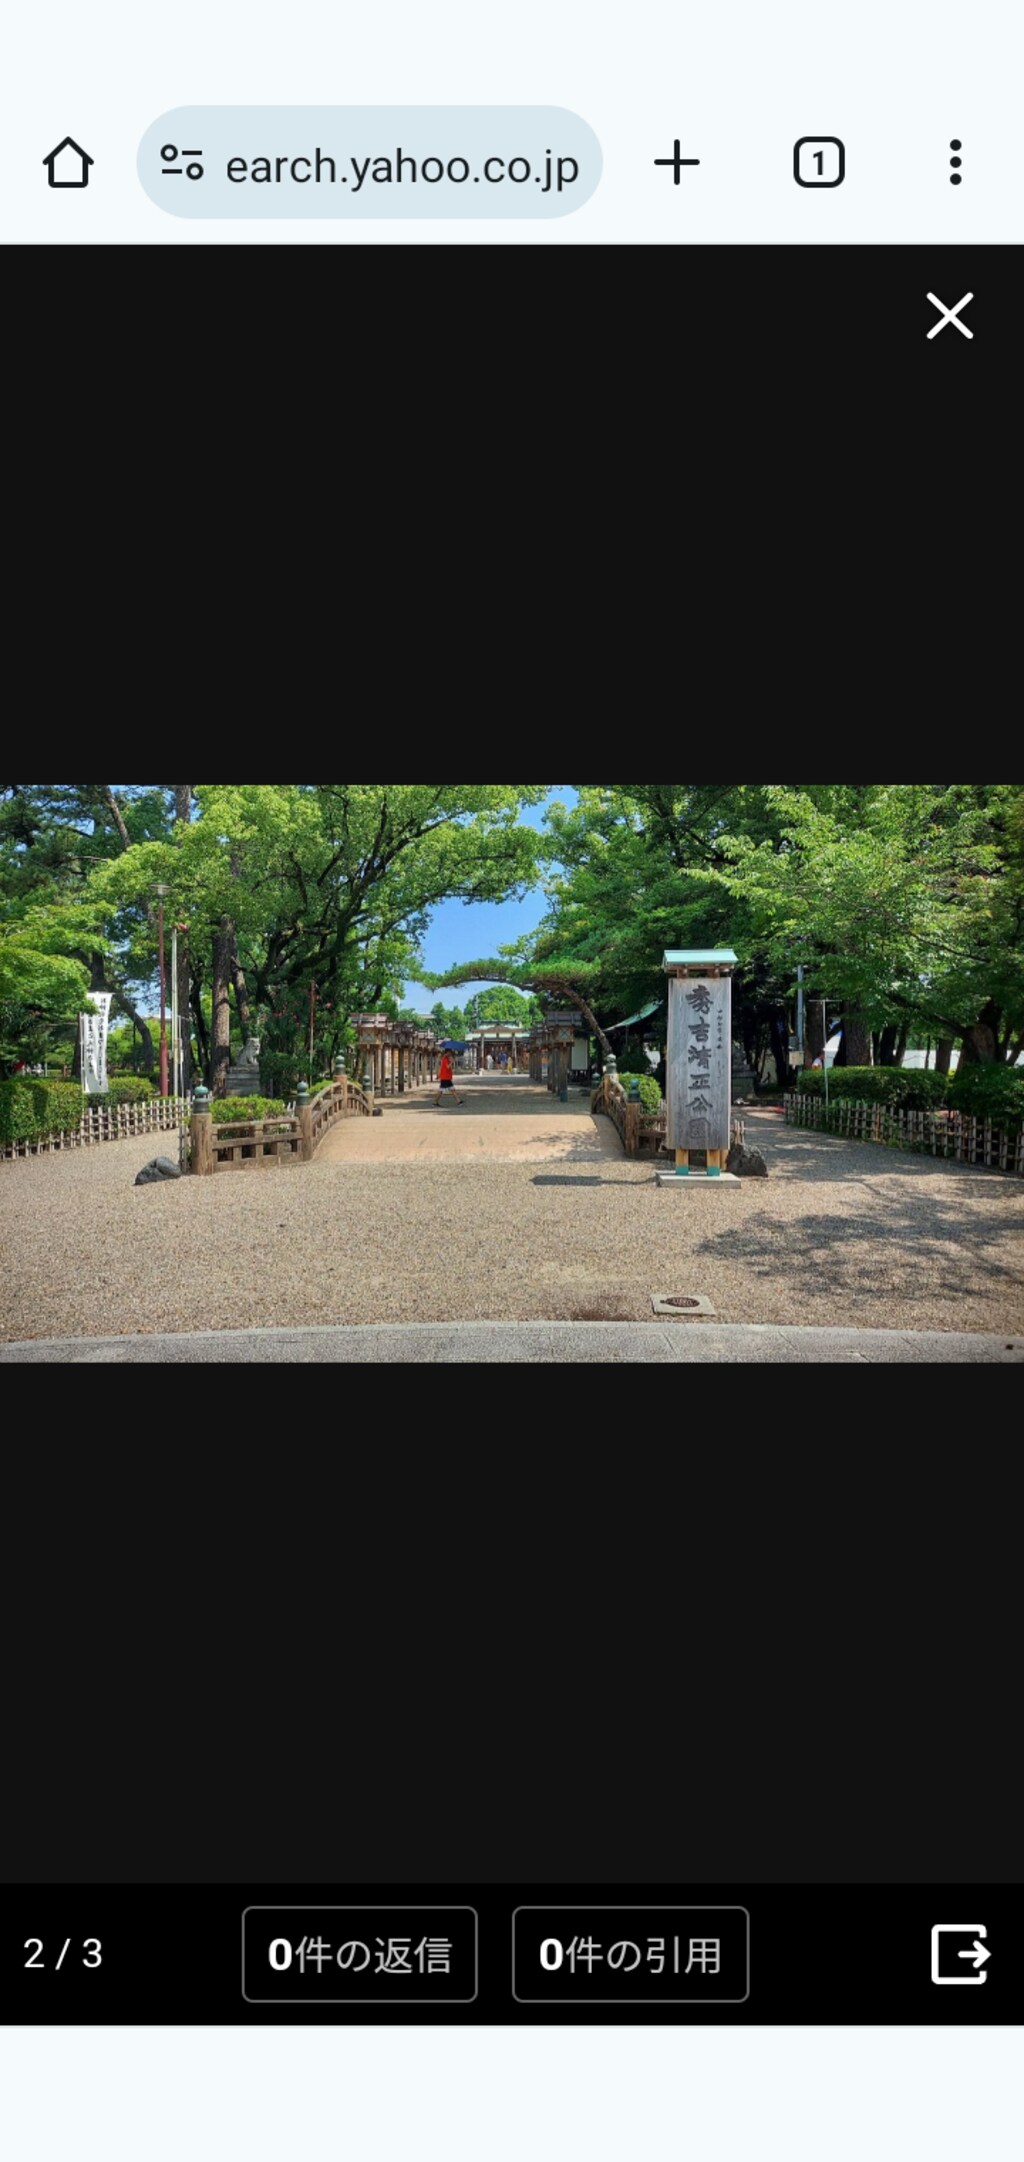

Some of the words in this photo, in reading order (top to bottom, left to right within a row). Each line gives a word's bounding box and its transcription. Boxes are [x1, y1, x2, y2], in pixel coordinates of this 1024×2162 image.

[226, 147, 579, 193] earch.yahoo.co.jp
[812, 150, 823, 176] 1
[23, 1938, 45, 1969] 2
[81, 1938, 102, 1969] 3
[268, 1936, 452, 1974] 0件の返信
[539, 1936, 721, 1974] 0件の引用
